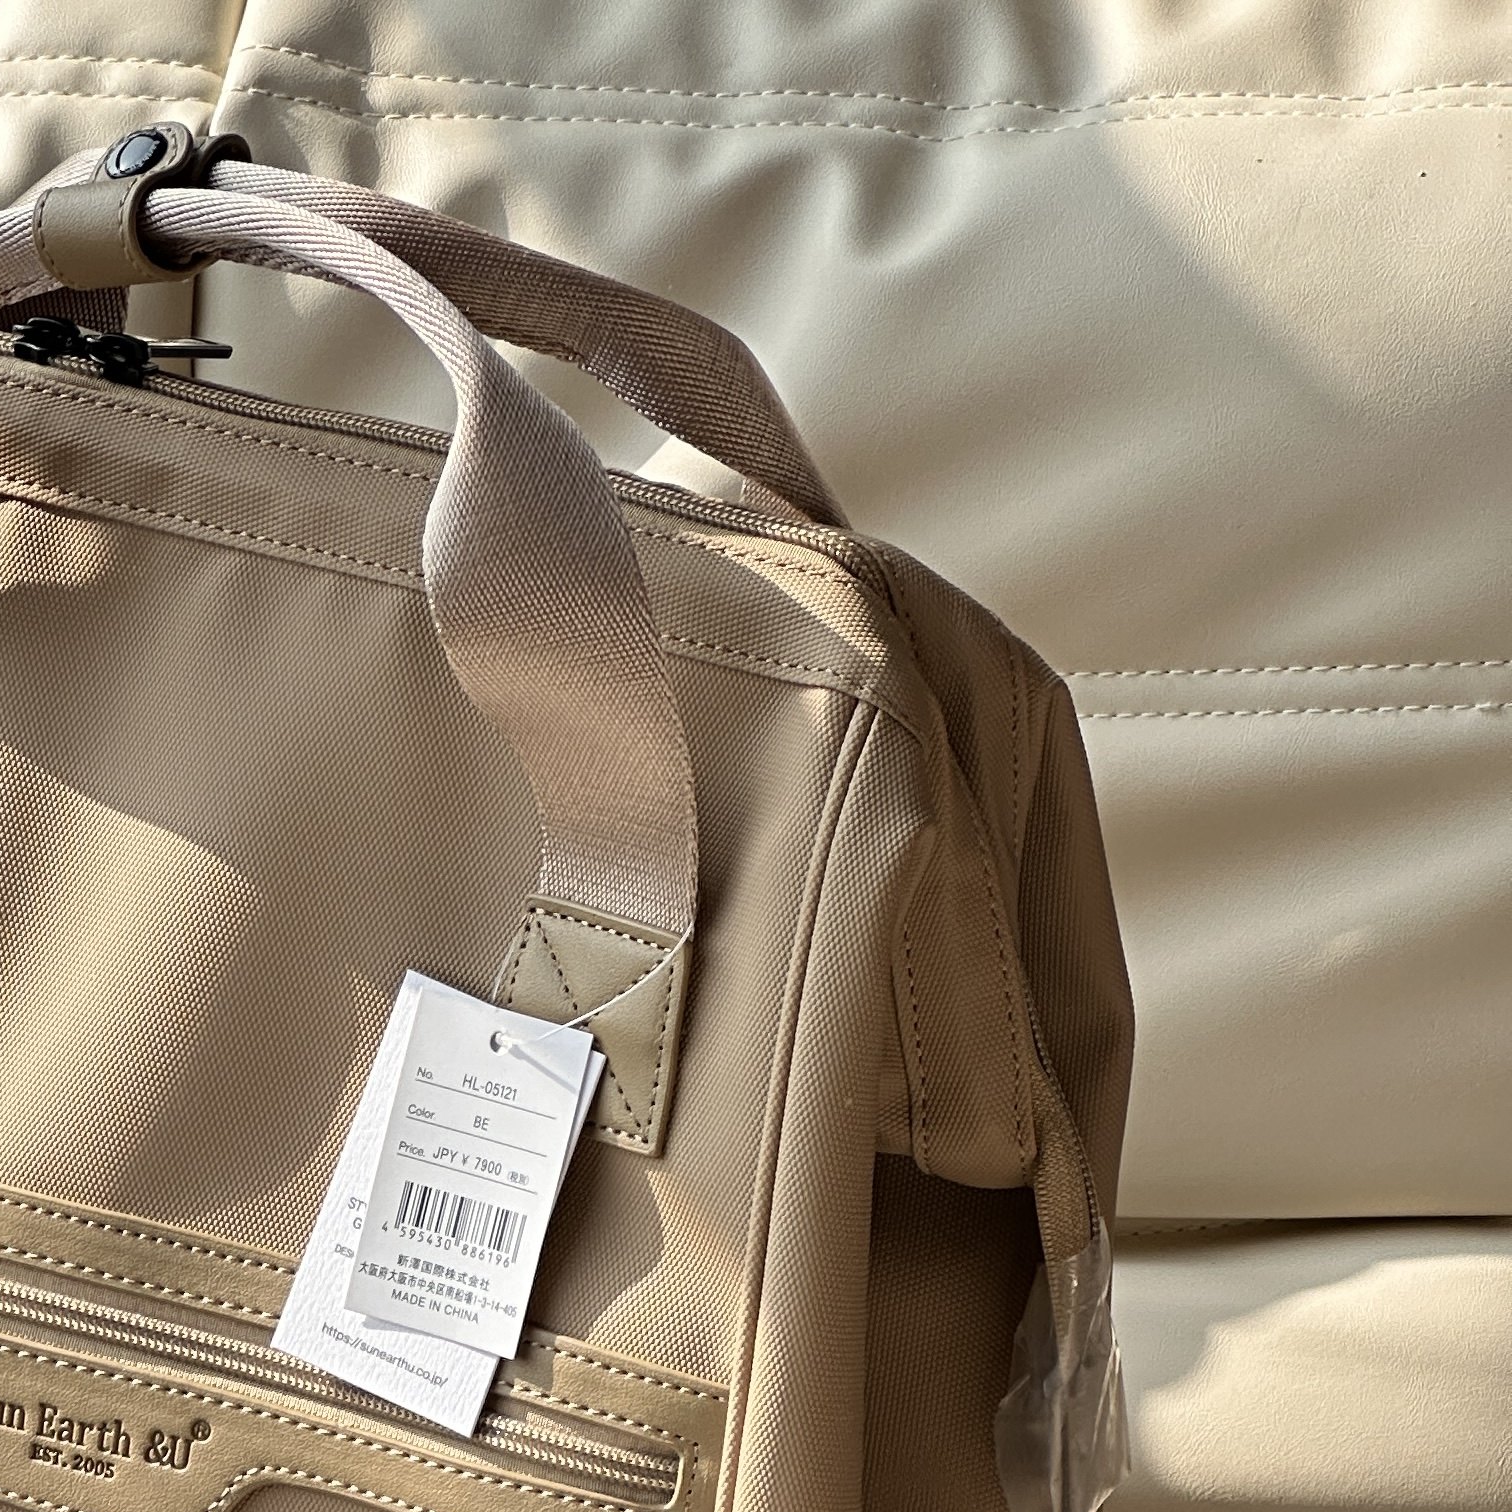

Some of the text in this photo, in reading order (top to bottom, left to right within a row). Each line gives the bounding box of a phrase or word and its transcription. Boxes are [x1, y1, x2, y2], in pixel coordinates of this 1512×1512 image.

[461, 1073, 518, 1101] HL-05121
[473, 1115, 490, 1131] BE
[433, 1146, 459, 1164] JPY
[474, 1156, 502, 1176] 7900
[348, 1196, 367, 1212] ST
[381, 1220, 511, 1269] 4 595430 886196
[391, 1288, 480, 1324] MADE IN CHINA
[36, 1401, 132, 1459] Earth
[29, 1442, 116, 1480] EST. 2005
